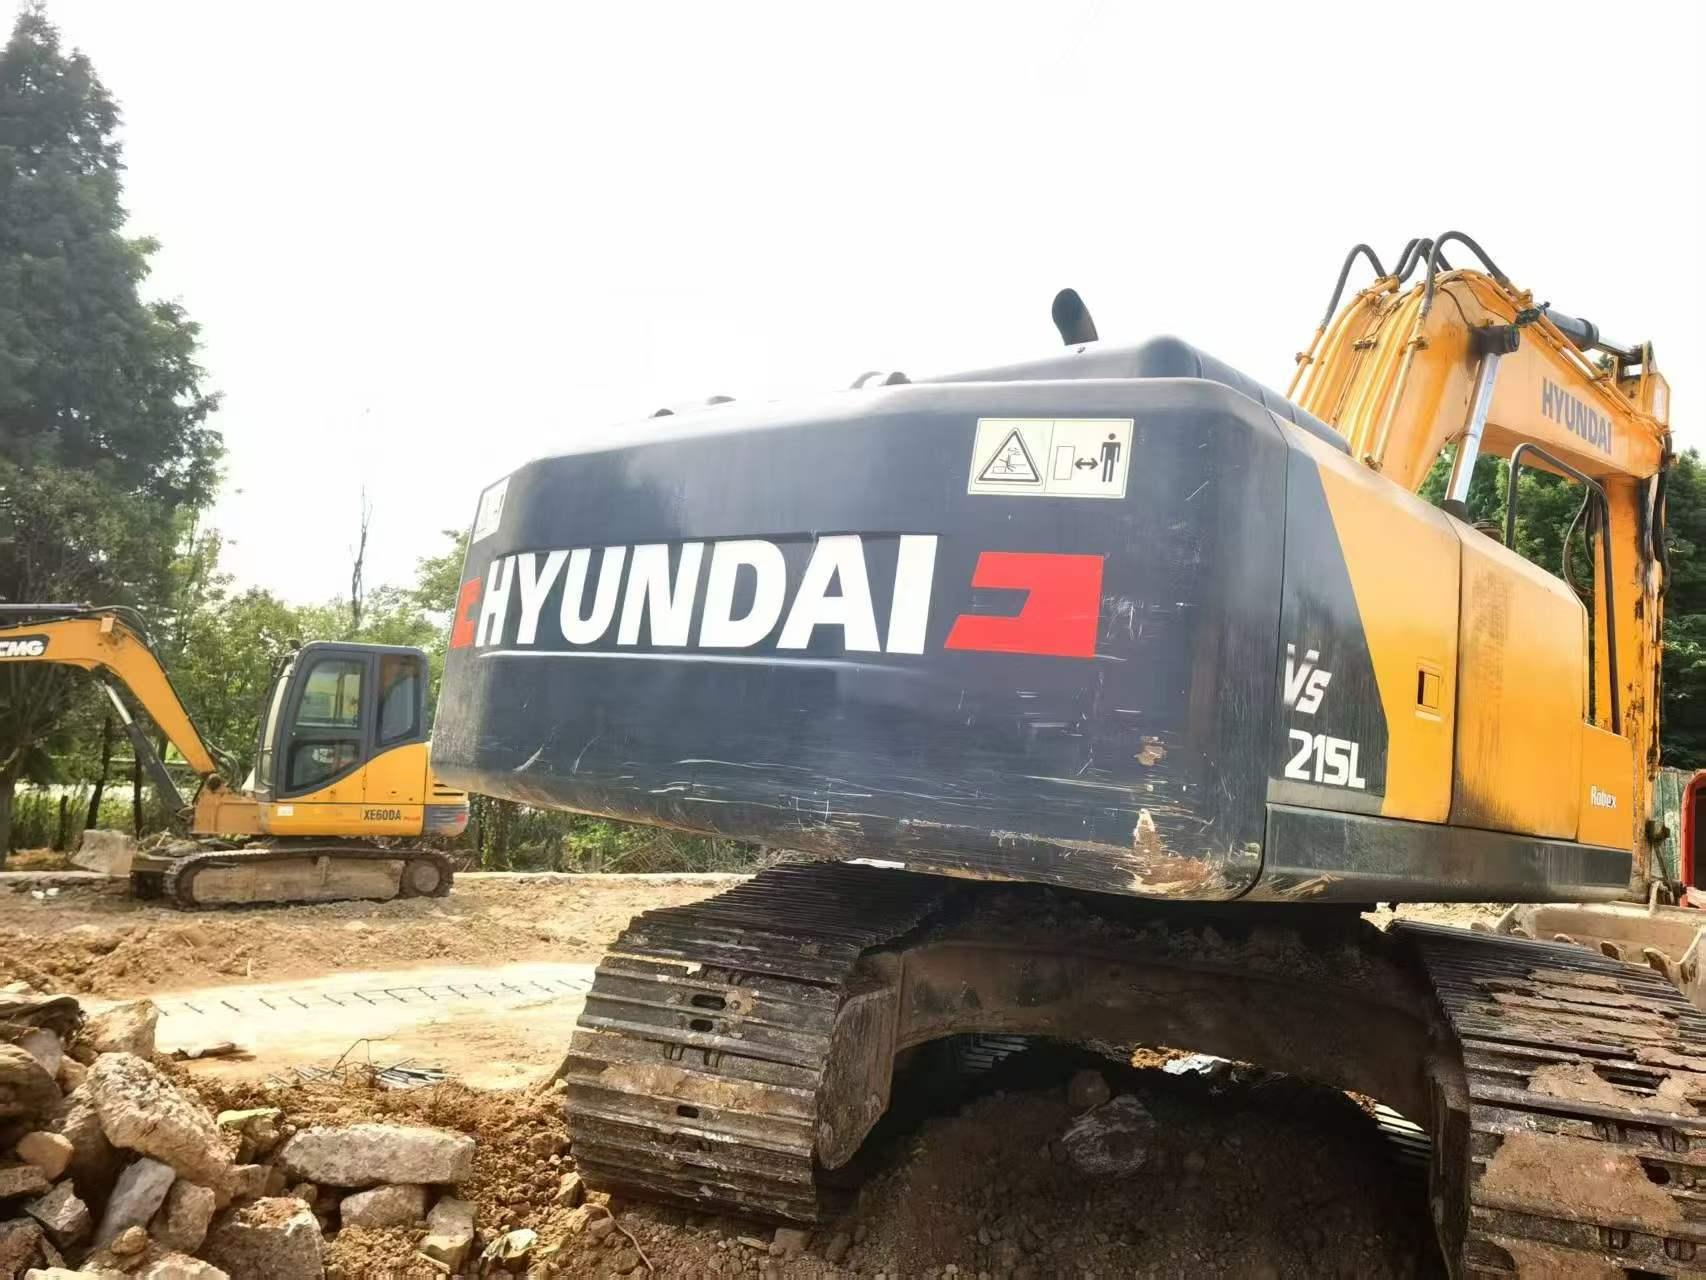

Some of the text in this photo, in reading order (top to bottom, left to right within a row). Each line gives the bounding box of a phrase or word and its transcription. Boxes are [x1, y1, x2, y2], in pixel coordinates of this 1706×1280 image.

[1542, 376, 1612, 455] HYUNDAI
[475, 534, 938, 655] HYUNDAI
[1284, 728, 1366, 789] 215L
[363, 809, 402, 821] XE60DA
